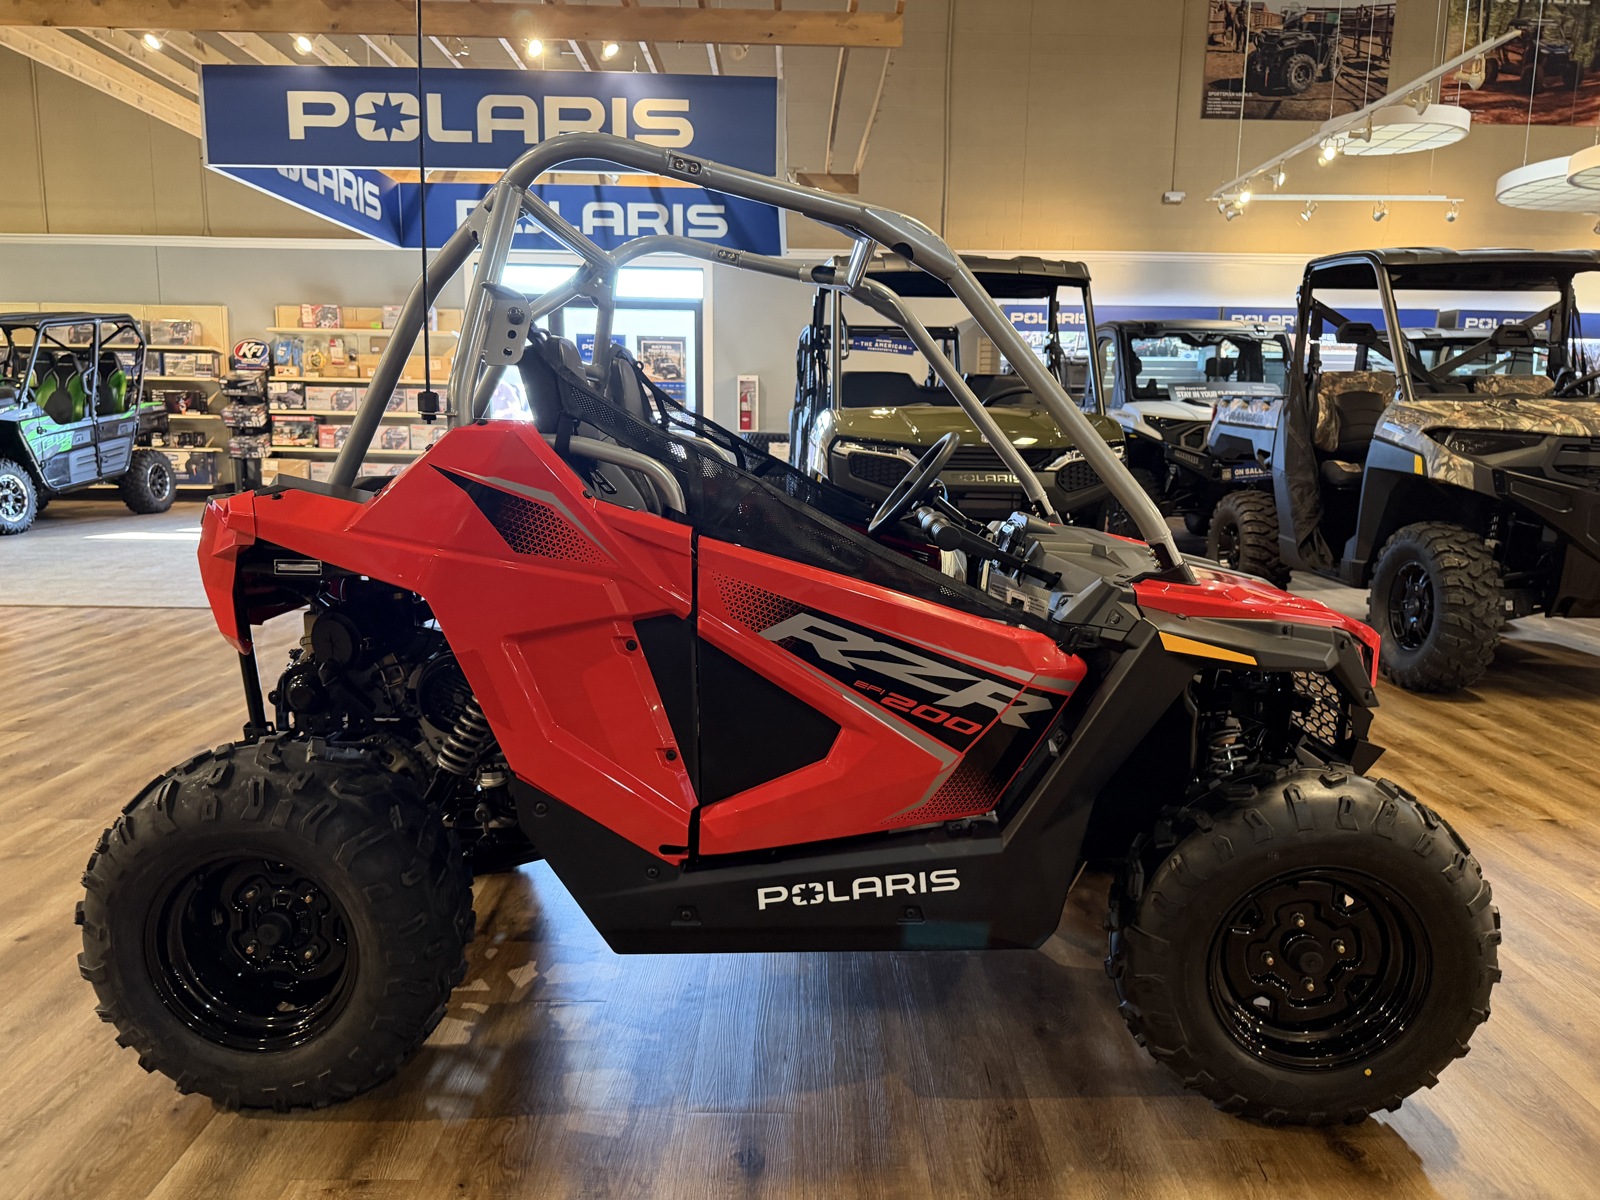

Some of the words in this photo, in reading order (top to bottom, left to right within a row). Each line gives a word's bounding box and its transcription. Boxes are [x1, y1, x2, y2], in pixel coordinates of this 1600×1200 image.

[286, 90, 695, 149] POLARIS
[238, 342, 265, 358] KFI
[874, 341, 907, 350] AMERICAN
[758, 612, 1053, 730] RZR
[853, 679, 886, 696] EFI
[880, 693, 983, 735] 200
[757, 868, 961, 911] POLARIS
